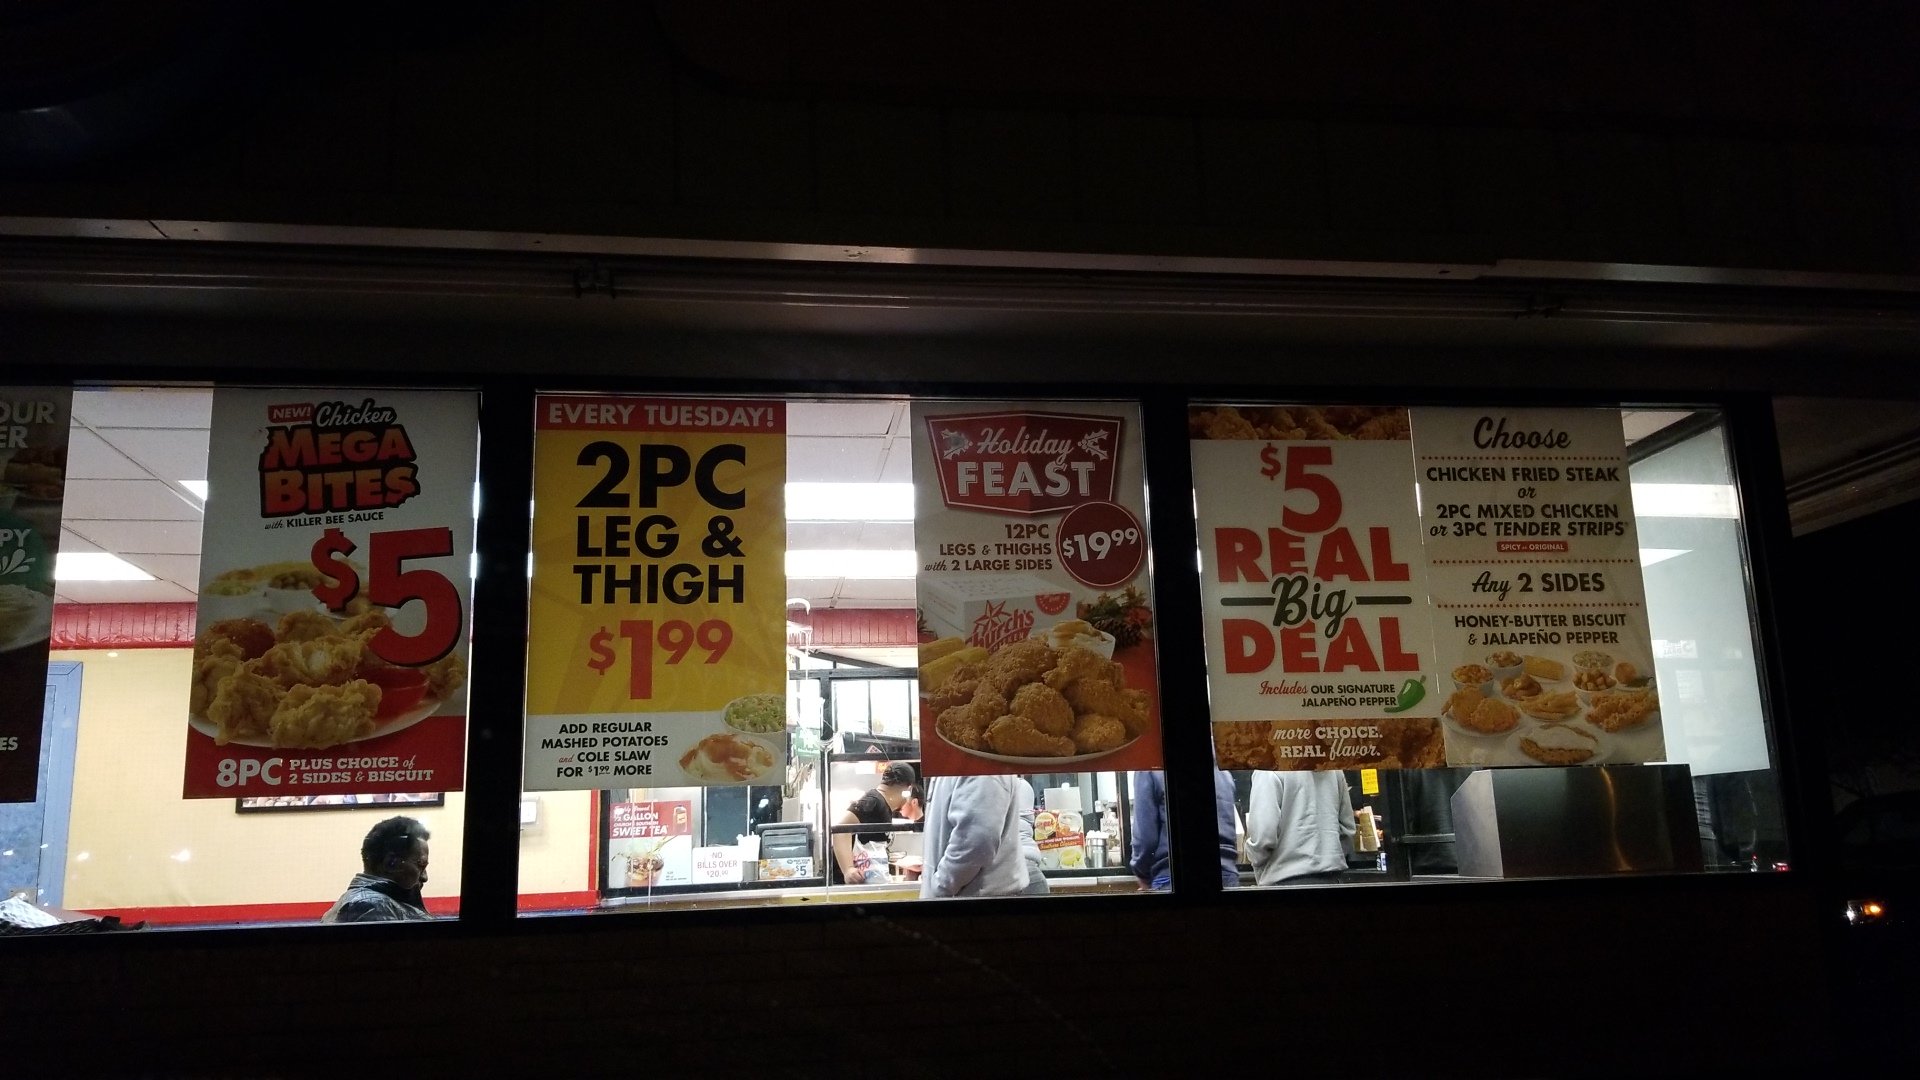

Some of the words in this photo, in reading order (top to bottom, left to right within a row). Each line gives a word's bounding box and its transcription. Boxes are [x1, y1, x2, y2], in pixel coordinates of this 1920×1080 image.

[272, 406, 312, 419] NEW!
[316, 404, 393, 427] Chicken
[550, 403, 636, 424] EVERY
[644, 405, 774, 428] TUESDAY!
[1473, 416, 1571, 450] Choose
[264, 426, 413, 470] MEGA
[977, 426, 1074, 465] Holiday
[575, 440, 746, 510] 2PC
[957, 461, 1096, 497] FEAST
[1426, 466, 1506, 482] CHICKEN
[1512, 467, 1560, 482] FRIED
[1566, 467, 1620, 482] STEAK
[264, 464, 417, 515] BITES
[1260, 442, 1343, 533] $5
[1518, 486, 1537, 499] or
[1436, 504, 1471, 519] 2PC
[1477, 504, 1535, 519] MIXED
[1541, 504, 1619, 519] CHICKEN
[265, 519, 283, 529] with
[286, 516, 322, 528] KILLER
[325, 514, 345, 525] BEE
[348, 512, 384, 523] SAUCE
[577, 515, 680, 558] LEG
[702, 515, 746, 558] &
[1005, 523, 1050, 539] 12PC
[1430, 524, 1449, 537] or
[1453, 522, 1487, 537] 3PC
[1494, 522, 1561, 536] TENDER
[939, 543, 976, 556] LEGS
[982, 544, 991, 555] &
[994, 543, 1052, 556] THIGHS
[1215, 527, 1411, 583] REAL
[1501, 543, 1521, 551] SPICY
[1529, 543, 1565, 551] ORIGINAL
[924, 560, 947, 572] with
[952, 560, 961, 571] 2
[965, 559, 1010, 571] LARGE
[1016, 559, 1053, 571] SIDES
[573, 563, 744, 605] THIGH
[1472, 570, 1511, 602] Any
[1517, 573, 1533, 592] 2
[1541, 573, 1605, 592] SIDES
[311, 526, 462, 667] $5
[1271, 575, 1353, 639] Big
[1454, 614, 1567, 628] HONEY-BUTTER
[1572, 613, 1626, 627] BISCUIT
[1222, 616, 1421, 674] DEAL
[1468, 633, 1477, 646] &
[1482, 628, 1561, 645] JALAPEÑO
[1567, 631, 1619, 644] PEPPER
[1259, 680, 1308, 695] Includes
[1311, 685, 1334, 694] OUR
[1338, 684, 1396, 694] SIGNATURE
[1301, 695, 1357, 707] JALAPEÑO
[1360, 697, 1397, 706] PEPPER
[559, 723, 588, 735] ADD
[592, 722, 652, 734] REGULAR
[1273, 728, 1312, 740] more
[1315, 726, 1384, 740] CHOICE.
[541, 738, 598, 749] MASHED
[602, 736, 668, 748] POTATOES
[1280, 745, 1327, 758] REAL
[1329, 738, 1381, 761] flavor.
[289, 758, 333, 770] PLUS
[337, 756, 398, 769] CHOICE
[403, 754, 416, 768] of
[559, 754, 575, 763] and
[577, 751, 610, 763] COLE
[614, 750, 651, 762] SLAW
[216, 757, 283, 787] 8PC
[289, 773, 298, 784] 2
[302, 772, 351, 784] SIDES
[355, 771, 365, 783] &
[367, 769, 434, 783] BISCUIT
[556, 766, 583, 778] FOR
[613, 764, 652, 776] MORE
[623, 812, 659, 821] GALLON
[612, 827, 648, 837] SWEET
[650, 825, 668, 835] TEA
[697, 861, 718, 869] BILLS
[719, 860, 738, 868] OVER
[795, 865, 807, 876] $5
